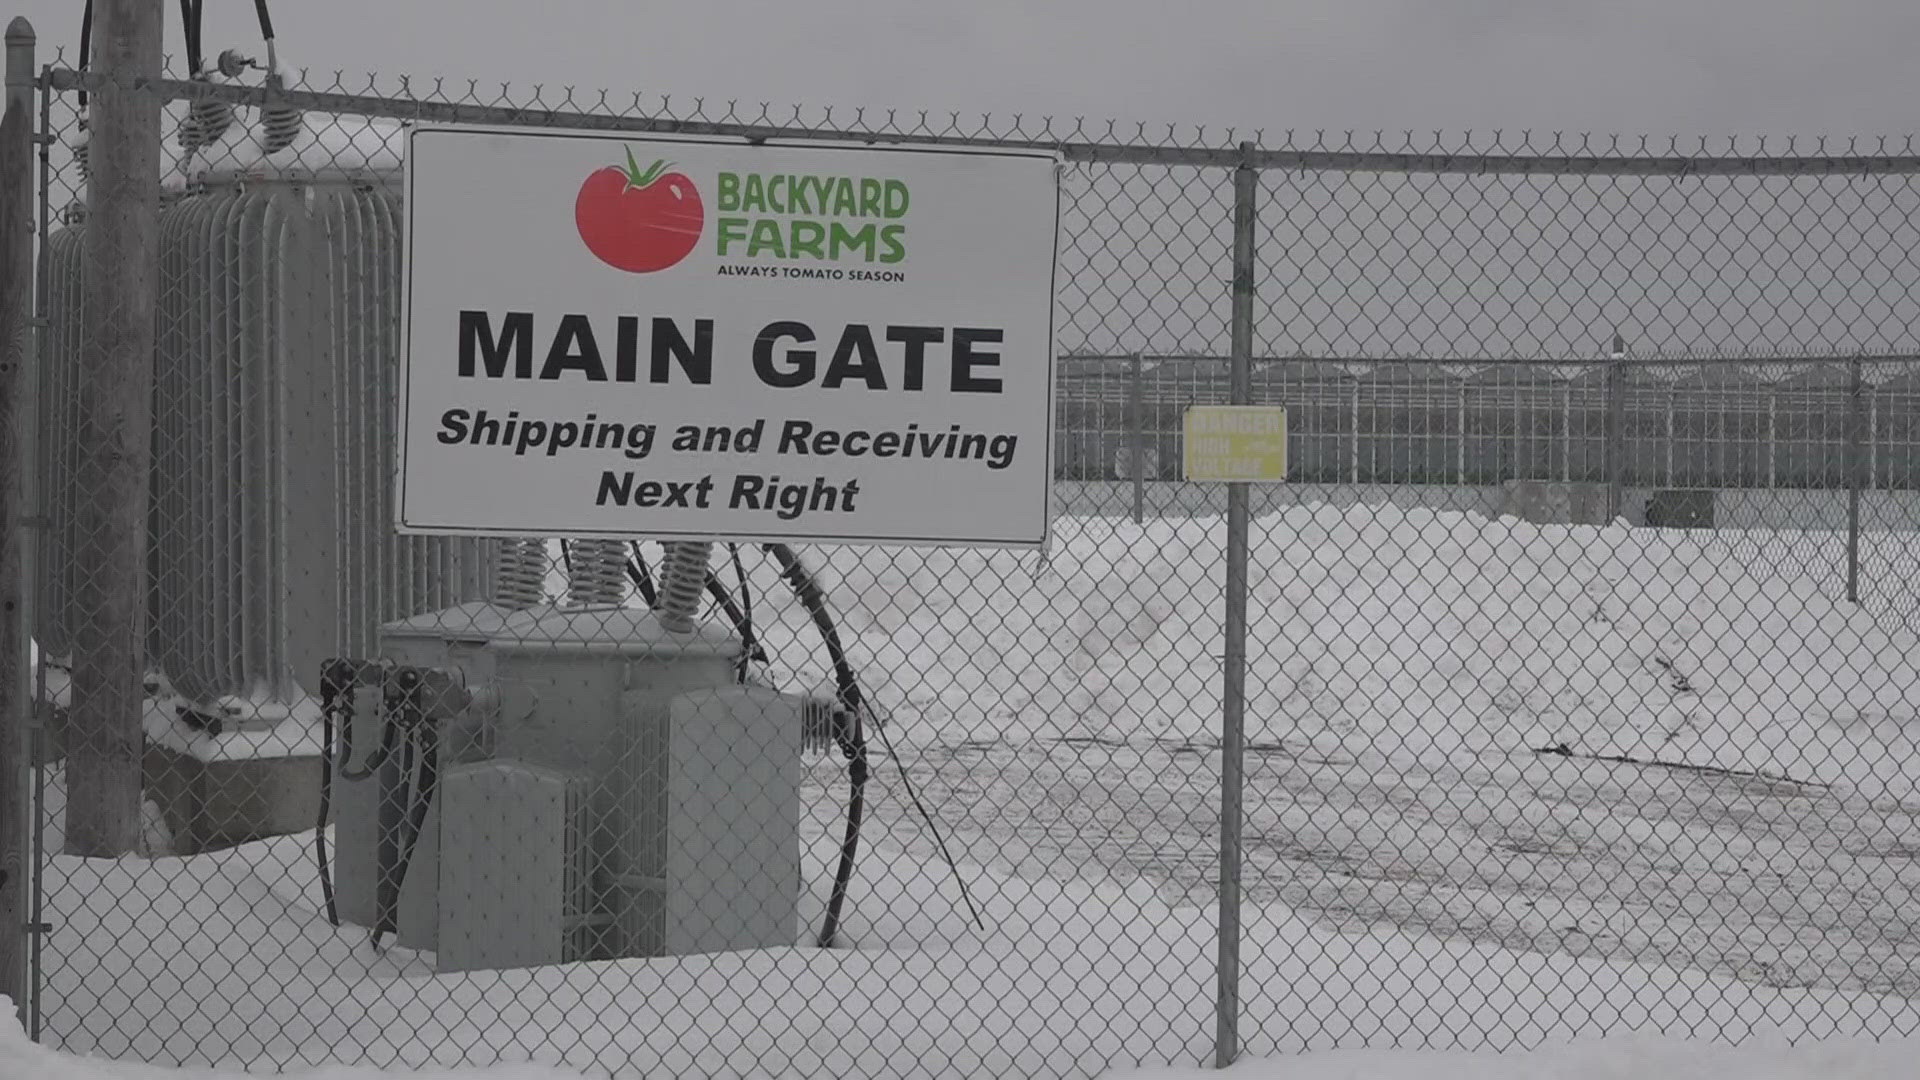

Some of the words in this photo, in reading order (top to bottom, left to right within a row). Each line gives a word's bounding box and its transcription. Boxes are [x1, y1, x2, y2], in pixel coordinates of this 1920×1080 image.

[718, 172, 910, 219] BACKYARD
[717, 217, 906, 264] FARMS
[717, 265, 778, 277] ALWAYS
[782, 267, 844, 280] TOMATO
[848, 270, 905, 283] SEASON
[457, 310, 714, 385] MAIN
[752, 320, 1004, 394] GATE
[436, 408, 657, 460] Shipping
[671, 419, 766, 453] and
[777, 420, 1018, 470] Receiving
[1191, 413, 1280, 433] DANGER
[595, 470, 714, 509] Next
[728, 474, 861, 521] Right
